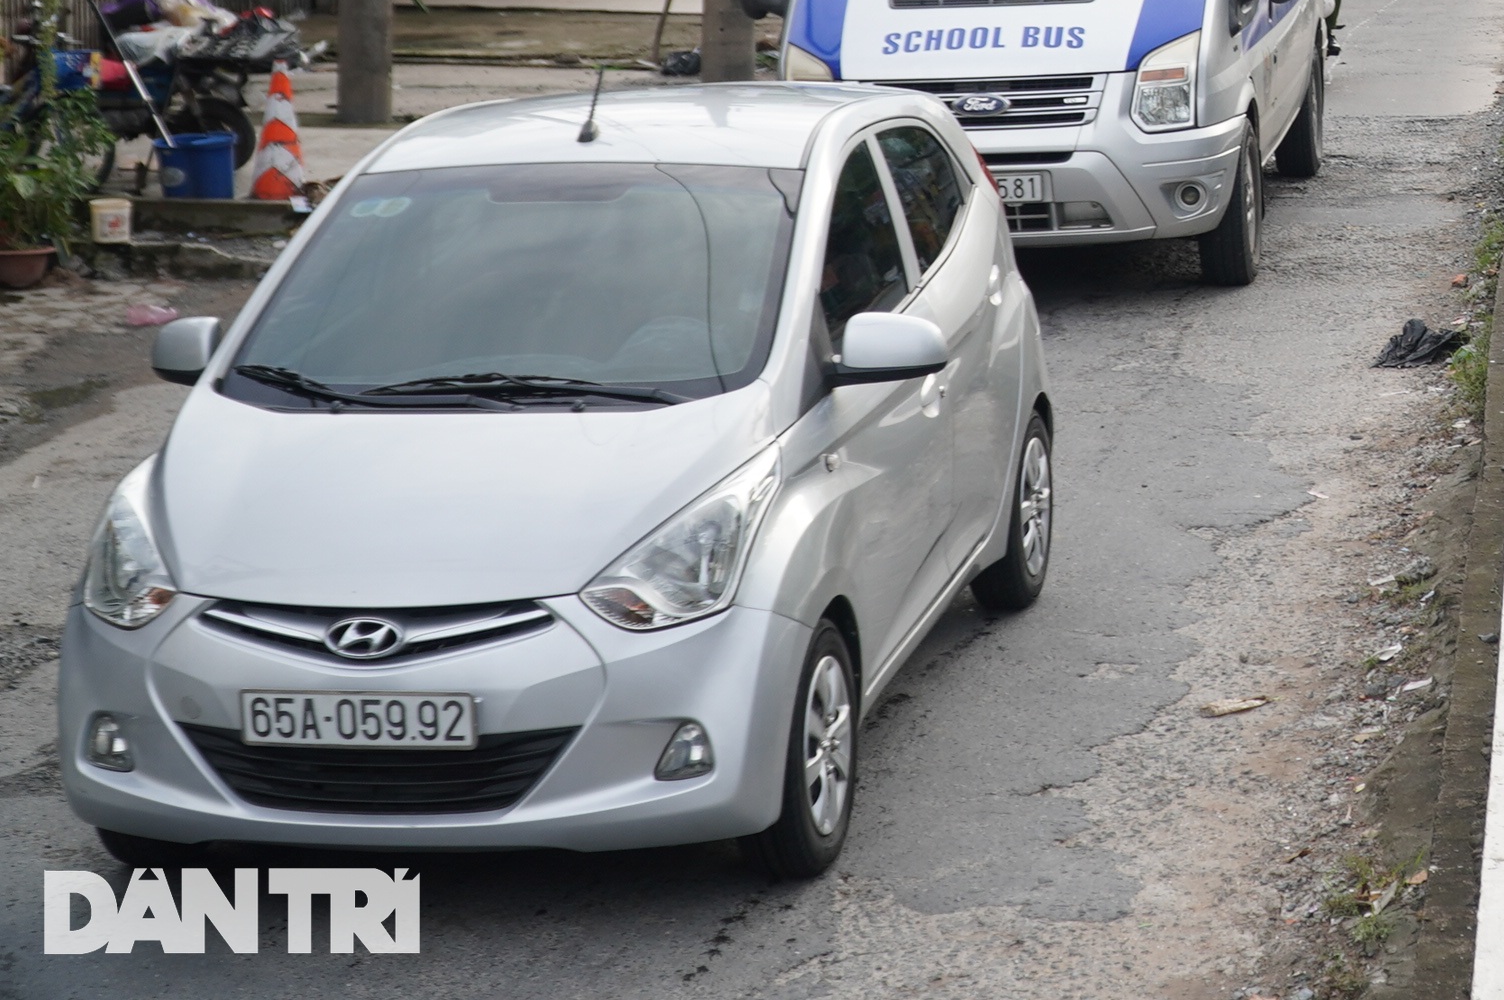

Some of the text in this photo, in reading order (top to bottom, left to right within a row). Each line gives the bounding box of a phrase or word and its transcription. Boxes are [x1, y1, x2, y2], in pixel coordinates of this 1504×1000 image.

[883, 26, 1086, 55] SCHOOL BUS
[962, 96, 998, 113] Ford
[997, 177, 1038, 200] 5.81
[250, 697, 467, 743] 65A-059.92
